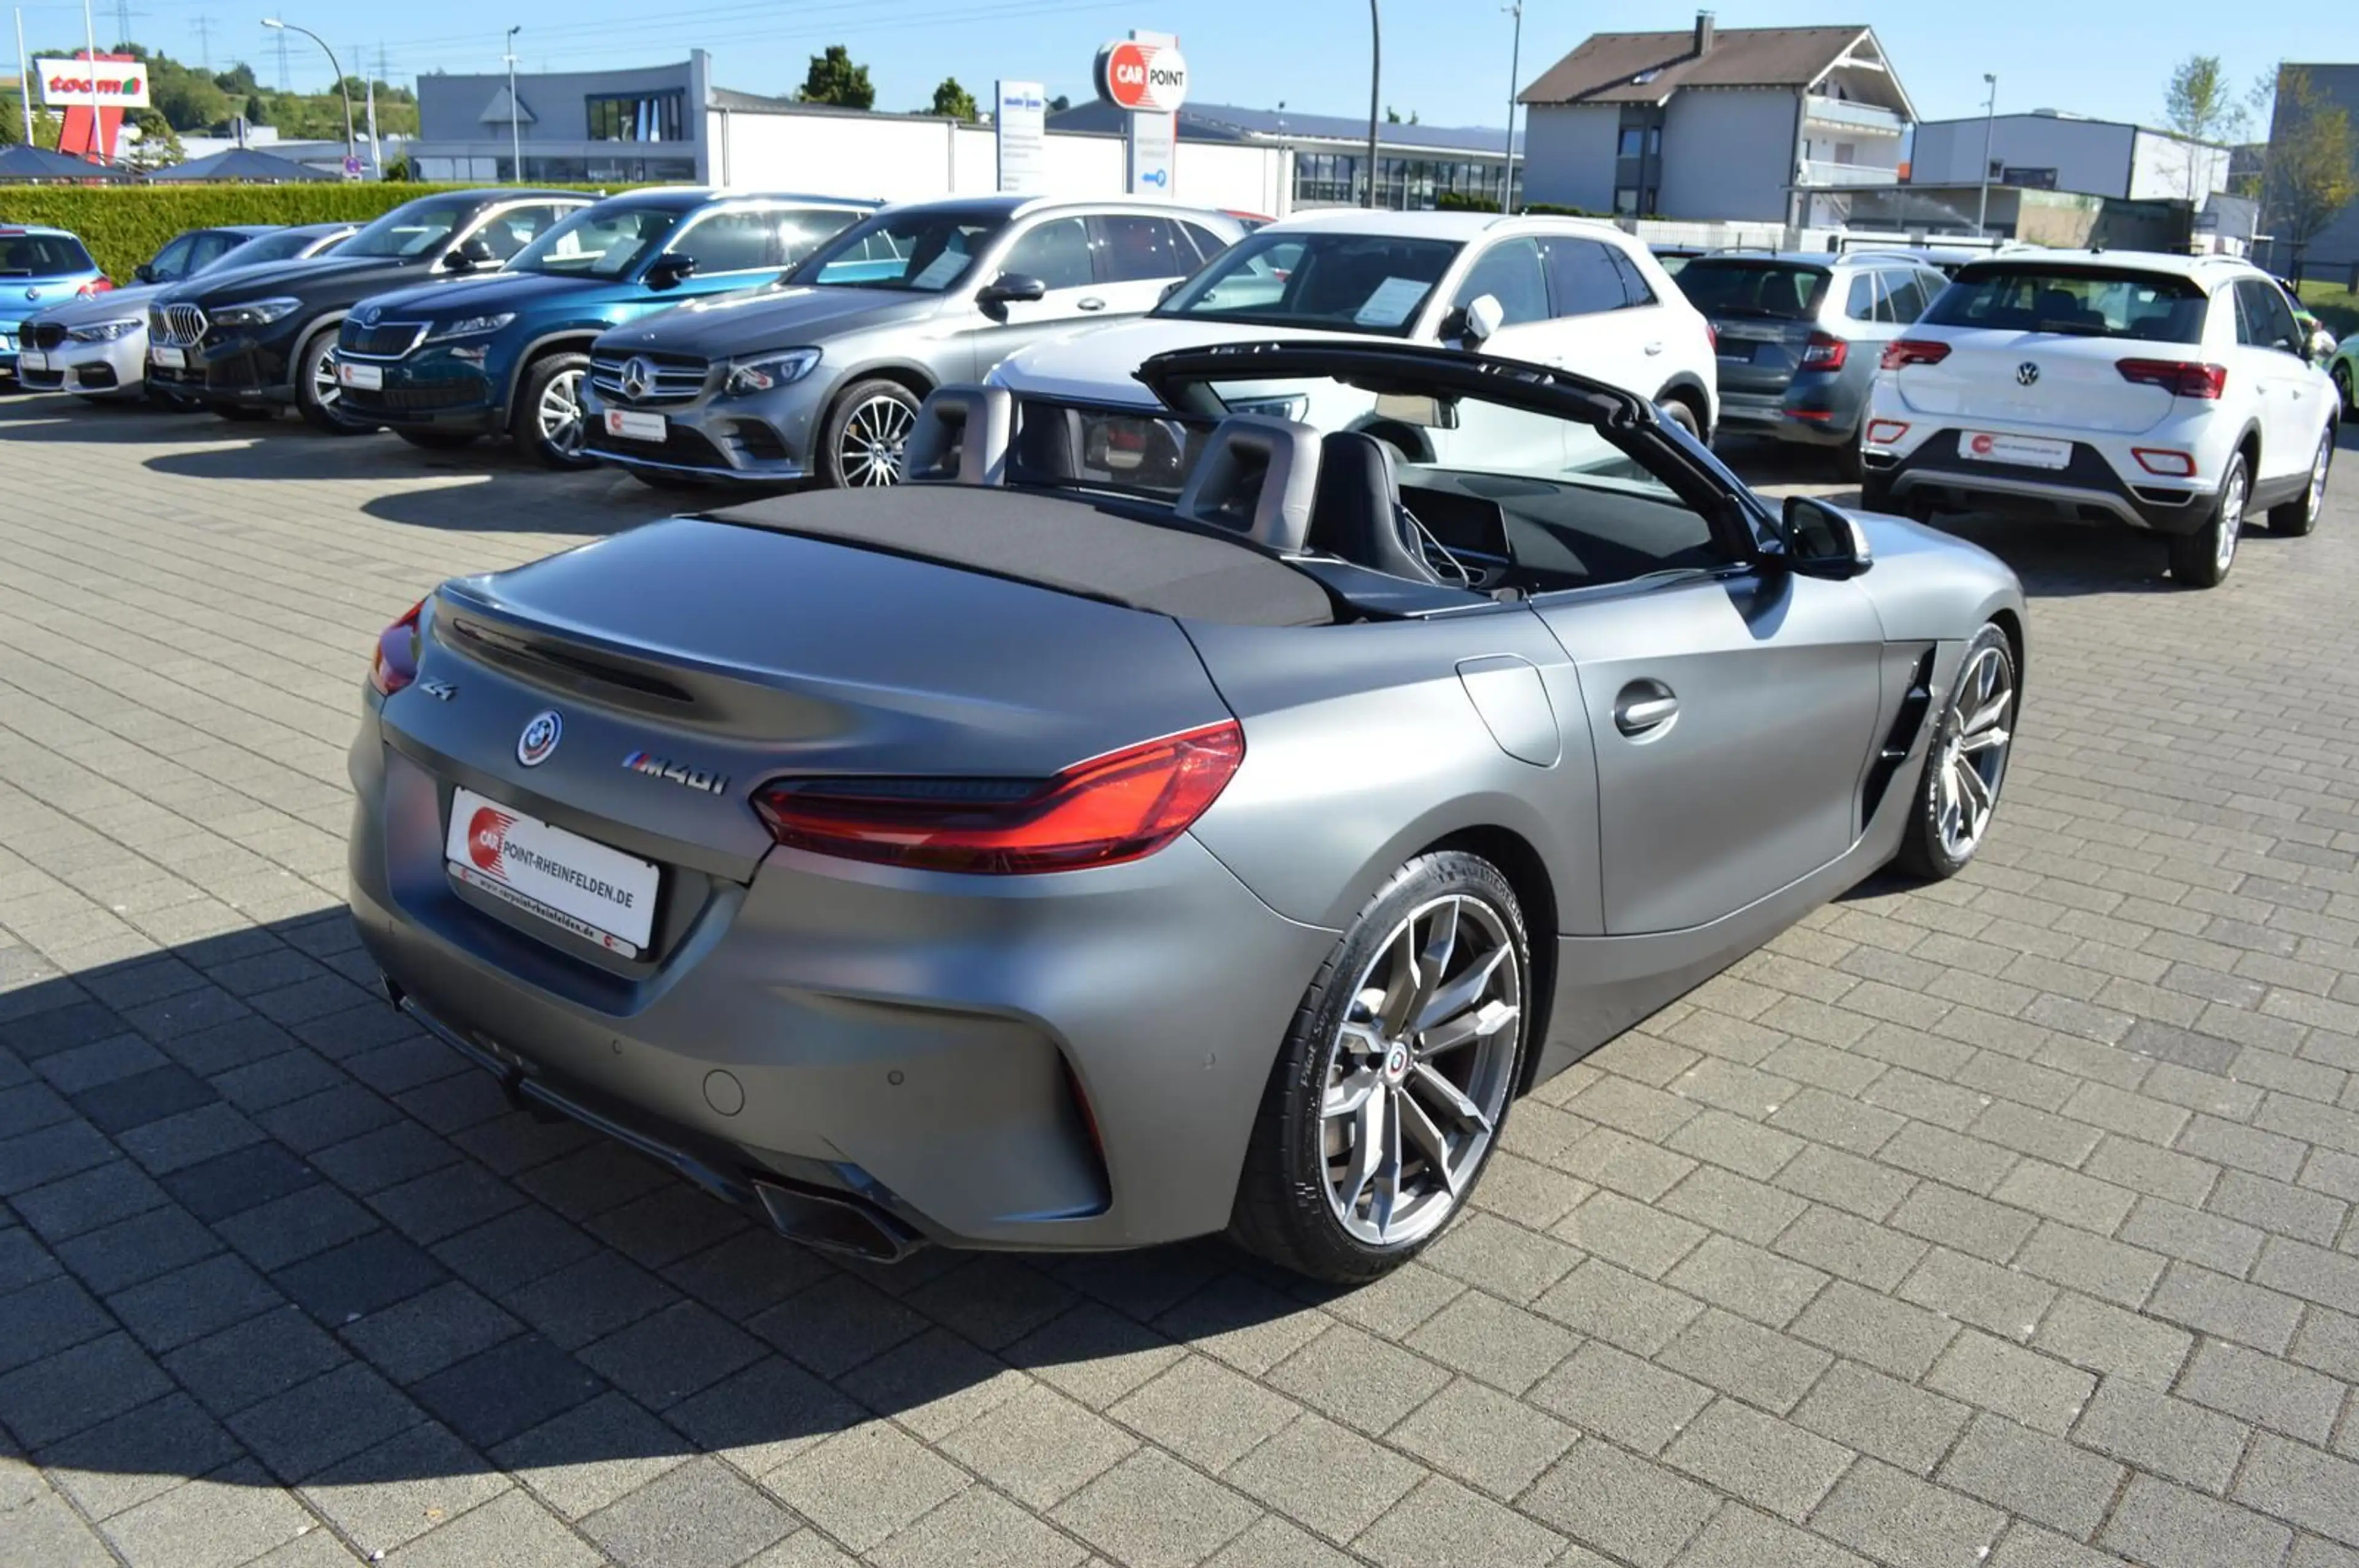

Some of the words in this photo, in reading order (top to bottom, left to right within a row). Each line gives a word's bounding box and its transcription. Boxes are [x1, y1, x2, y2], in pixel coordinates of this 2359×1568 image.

[49, 74, 122, 94] toom
[1116, 63, 1144, 85] CAR
[1150, 68, 1184, 87] POINT
[419, 676, 456, 701] Z4
[479, 829, 500, 851] CAR
[503, 840, 635, 908] POINT-RHEINFELDEN.DE
